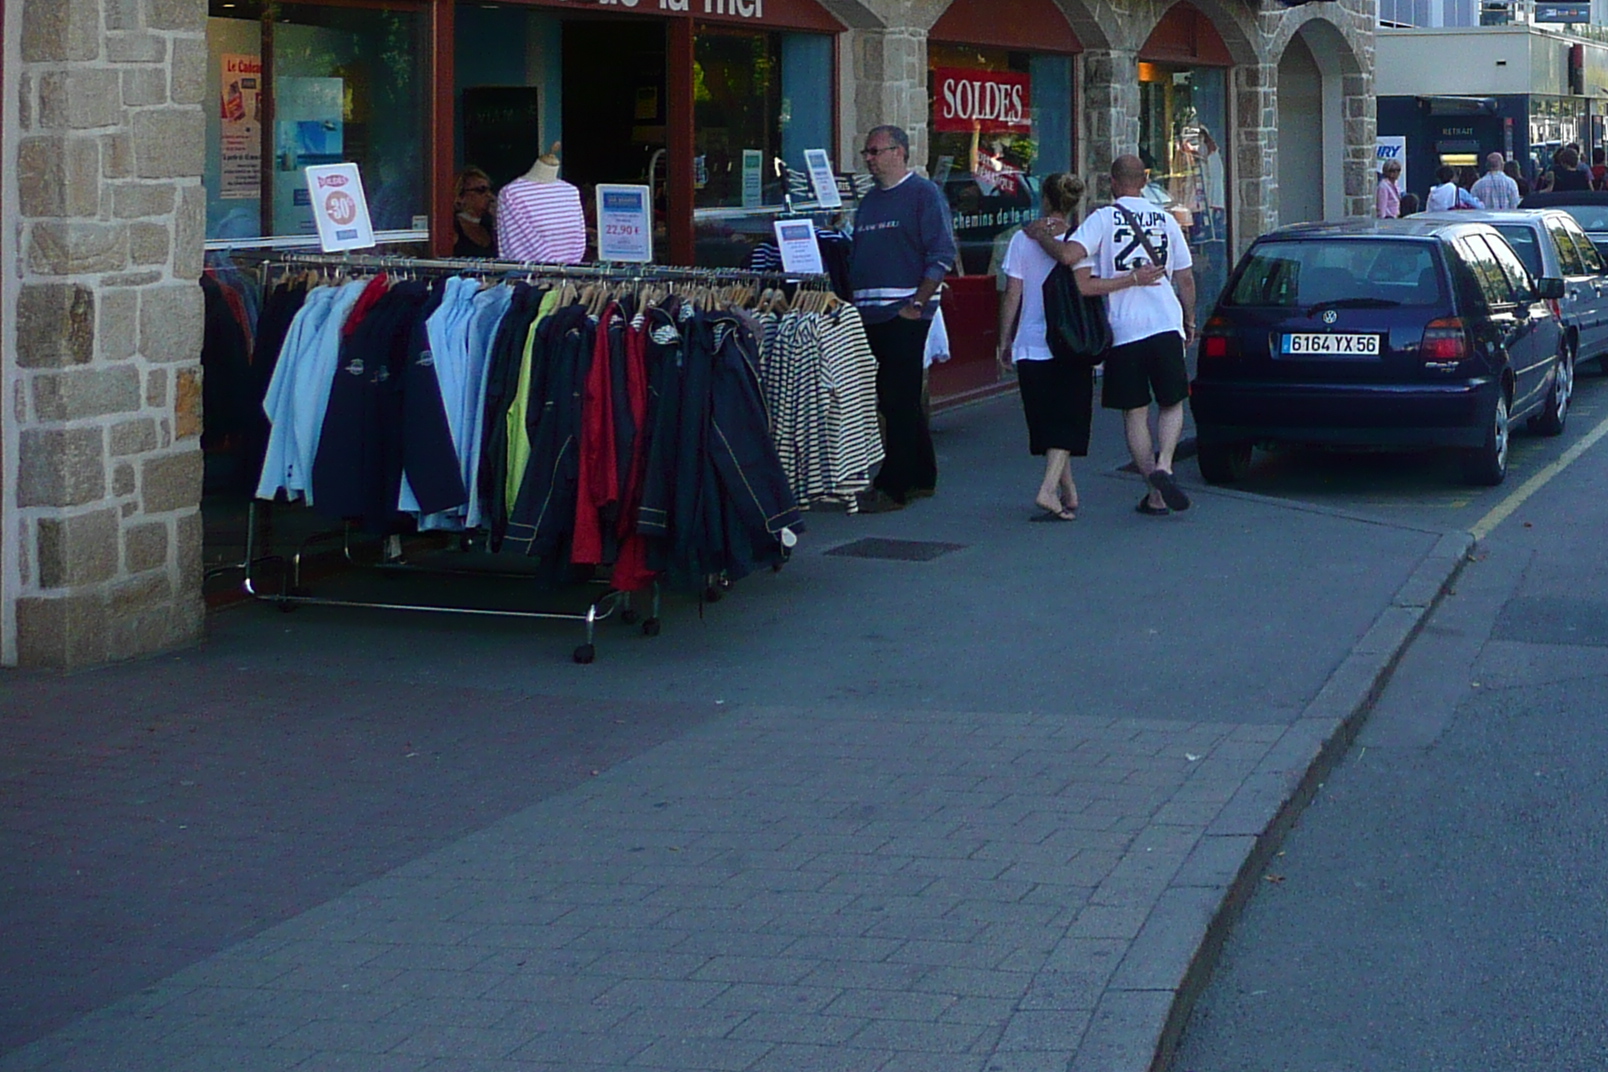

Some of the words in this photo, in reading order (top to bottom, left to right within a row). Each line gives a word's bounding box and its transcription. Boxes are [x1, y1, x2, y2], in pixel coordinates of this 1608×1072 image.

[238, 59, 263, 75] Cadea
[943, 78, 1023, 123] SOLDES
[1376, 145, 1402, 158] IRY
[953, 209, 994, 230] chemins
[997, 207, 1010, 225] de
[1292, 335, 1330, 352] 6164
[1335, 336, 1353, 352] YX
[1356, 336, 1376, 353] 56
